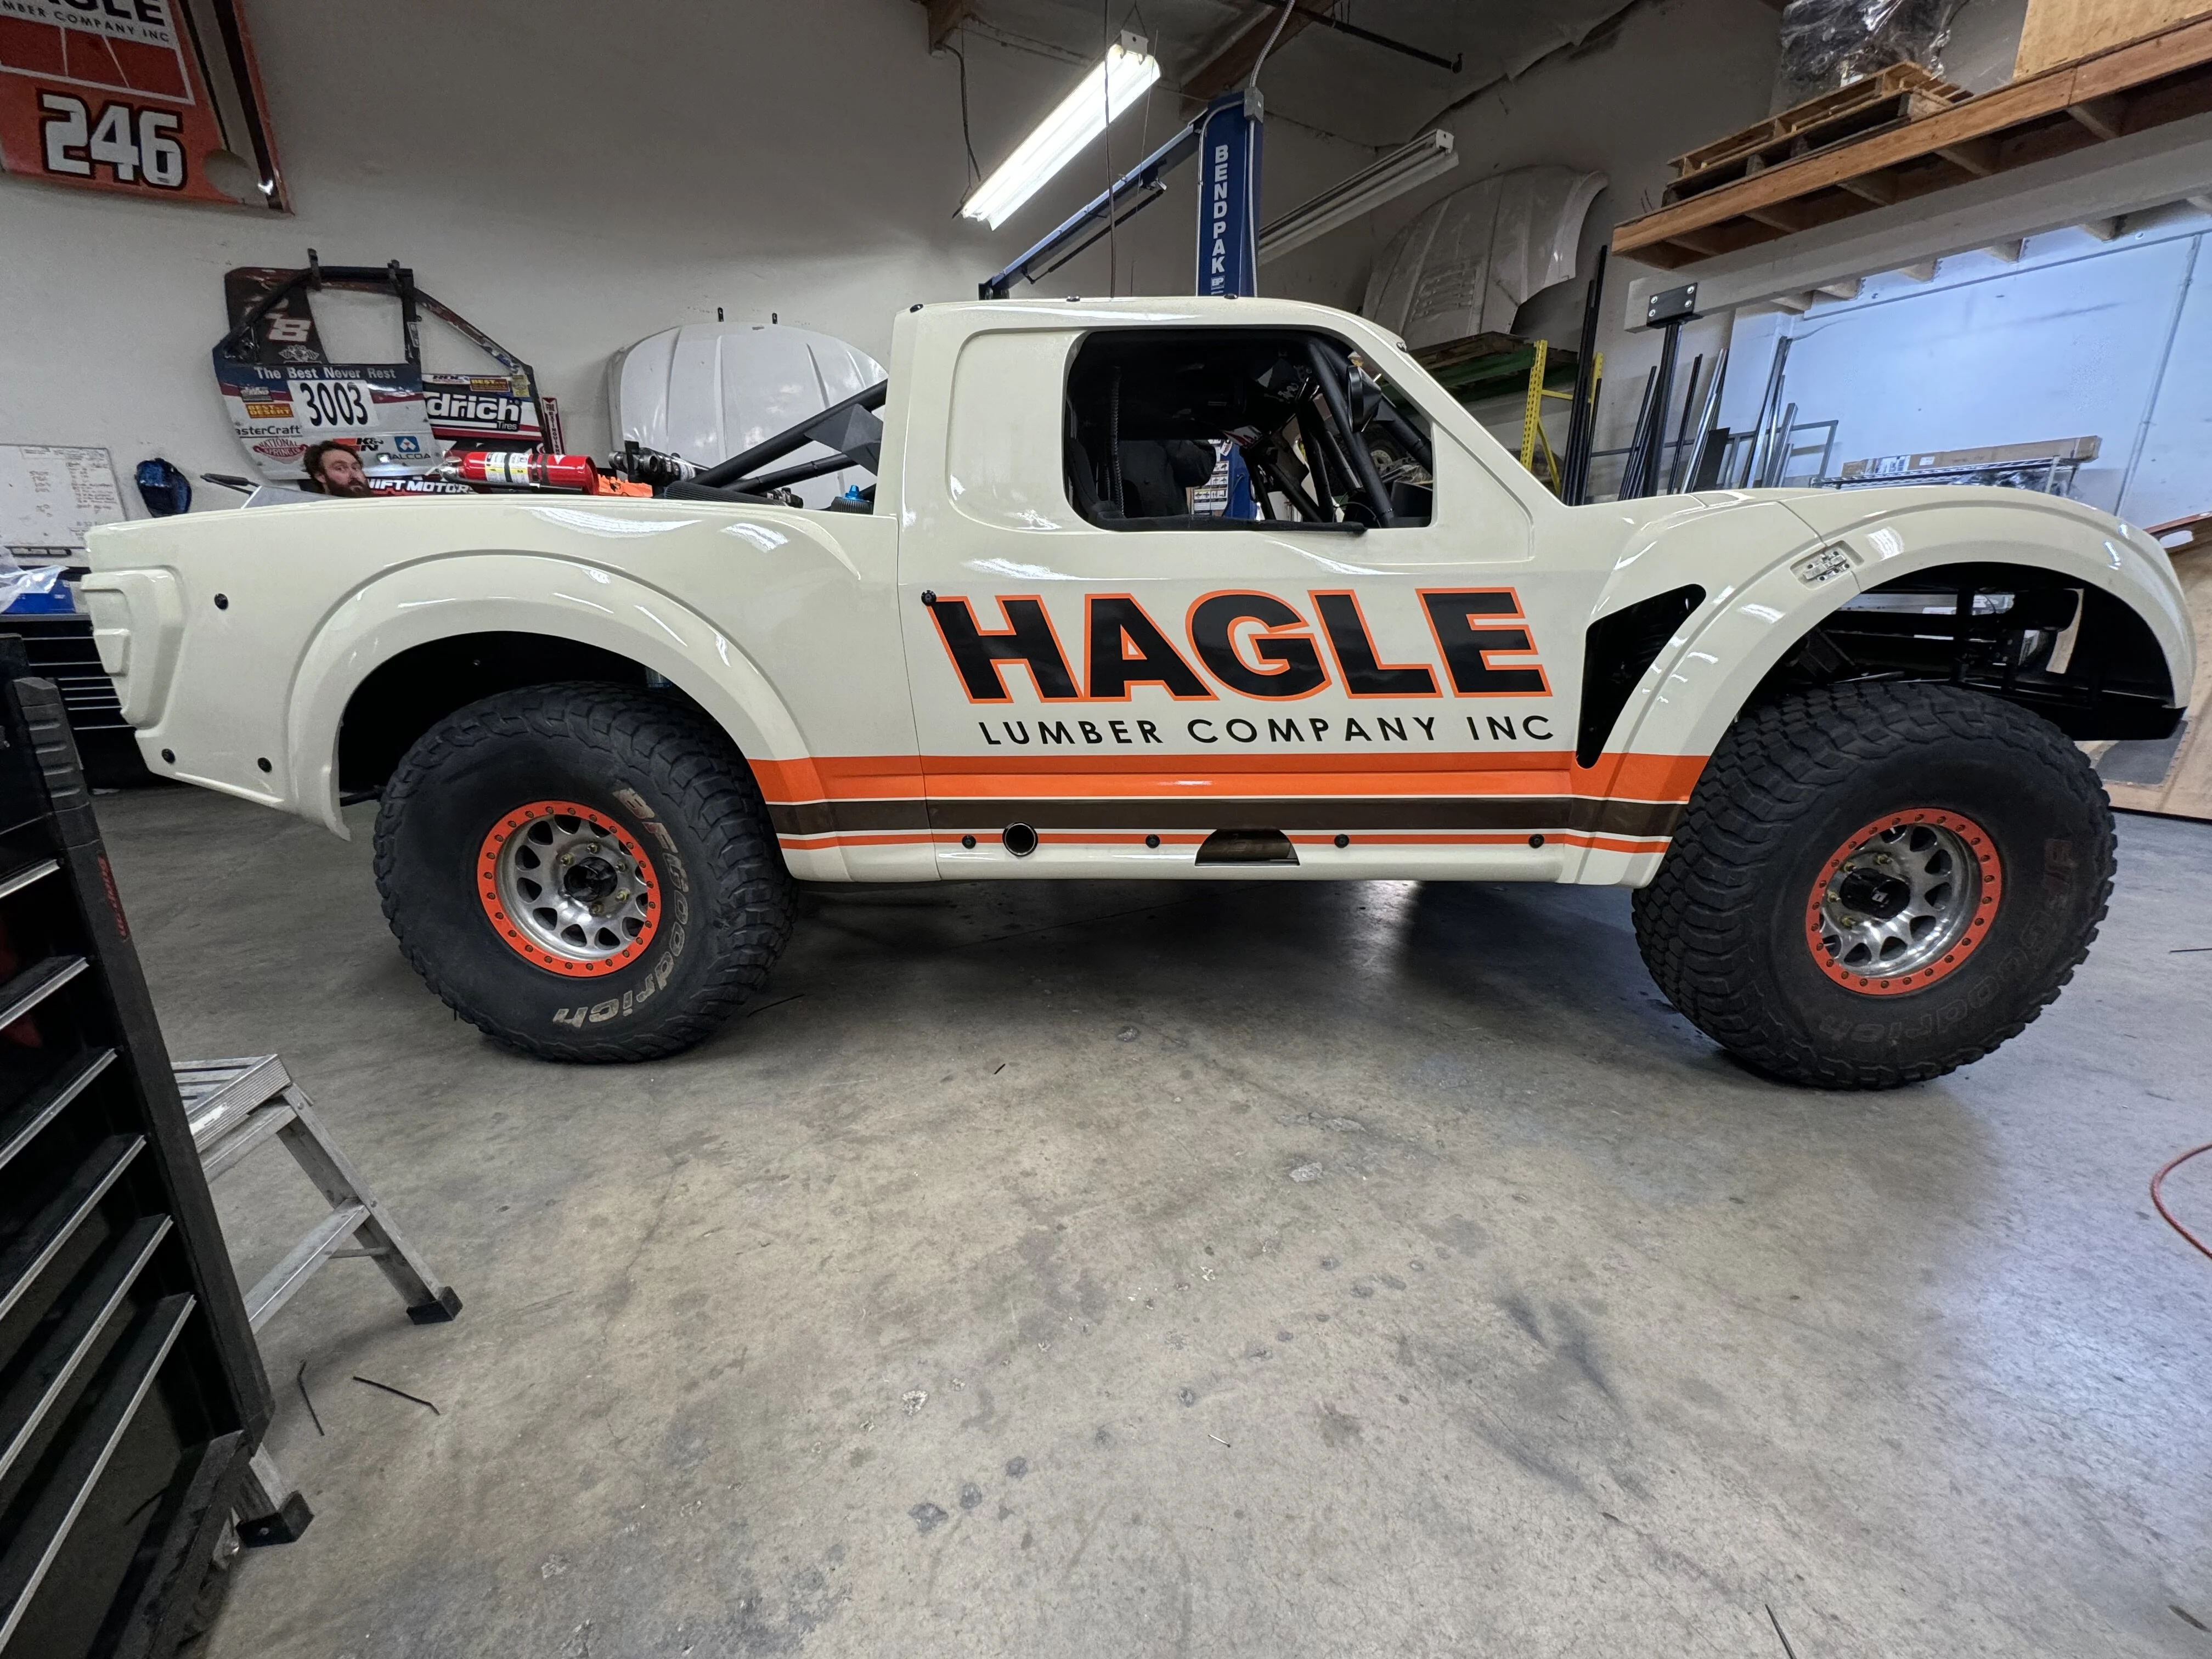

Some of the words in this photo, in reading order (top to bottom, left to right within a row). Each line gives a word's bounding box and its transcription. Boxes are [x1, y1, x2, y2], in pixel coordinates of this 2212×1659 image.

[54, 11, 134, 35] COMPANY
[143, 29, 170, 42] INC
[40, 89, 185, 189] 246
[1211, 144, 1229, 274] BENDPAK
[253, 366, 281, 379] The
[285, 366, 319, 379] Best
[323, 366, 361, 379] Never
[366, 367, 397, 379] Rest
[300, 382, 368, 426] 3003
[426, 393, 520, 422] drich
[497, 421, 517, 430] Tires
[259, 438, 298, 448] NATIONAL
[926, 586, 1554, 704] HAGLE
[978, 720, 1164, 747] LUMBER
[1187, 715, 1436, 746] COMPANY
[1467, 714, 1555, 741] INC
